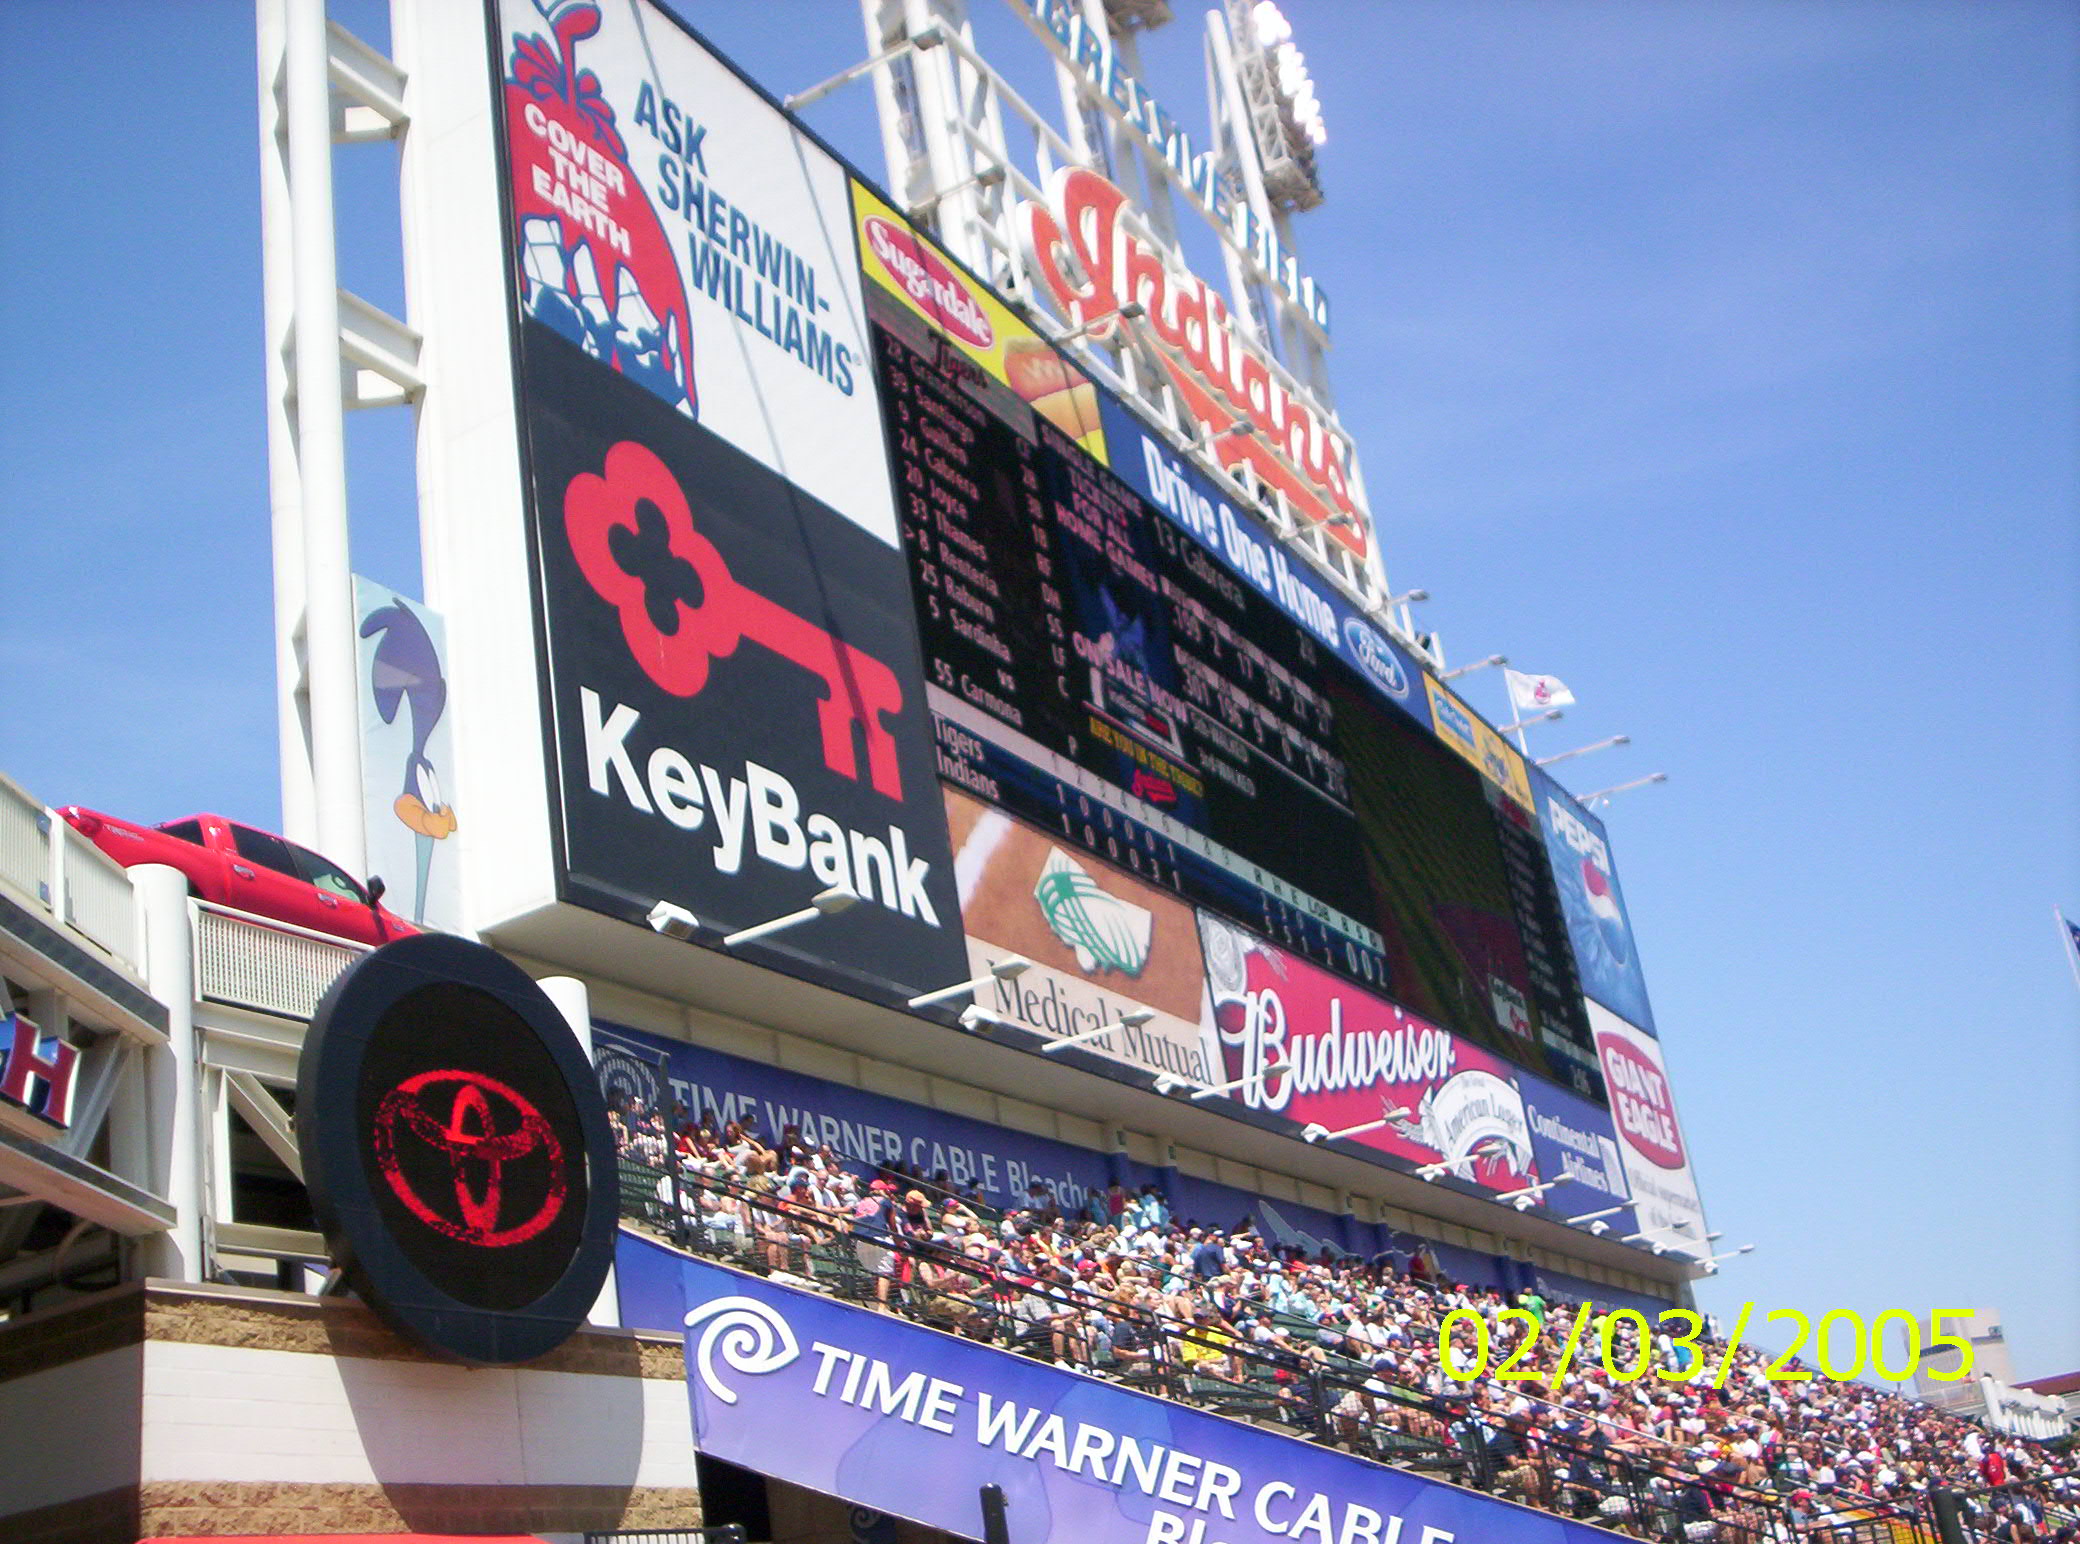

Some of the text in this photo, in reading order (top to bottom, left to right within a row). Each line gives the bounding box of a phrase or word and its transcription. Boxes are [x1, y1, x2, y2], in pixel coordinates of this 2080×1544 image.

[525, 103, 626, 197] COVER
[633, 79, 707, 178] ASK
[531, 164, 631, 257] EARTH
[549, 147, 609, 213] THE
[658, 153, 830, 314] SHERWIN-
[1015, 167, 1366, 560] Indians
[1141, 434, 1340, 648] Drive One Home
[935, 711, 984, 762] Tigers
[935, 745, 999, 799] Indians
[580, 686, 941, 928] KeyBank
[986, 957, 1115, 1052] Medical
[1117, 1007, 1216, 1087] Mutual
[1214, 987, 1456, 1111] Budweiser
[0, 1003, 82, 1128] H
[1605, 1046, 1668, 1111] GIANT
[764, 1100, 903, 1167] WARNER
[910, 1136, 1000, 1193] CABLE
[1527, 1104, 1601, 1159] Continental
[1616, 1090, 1679, 1153] EAGLE
[811, 1341, 964, 1436] TIME
[977, 1399, 1242, 1520] WARNER
